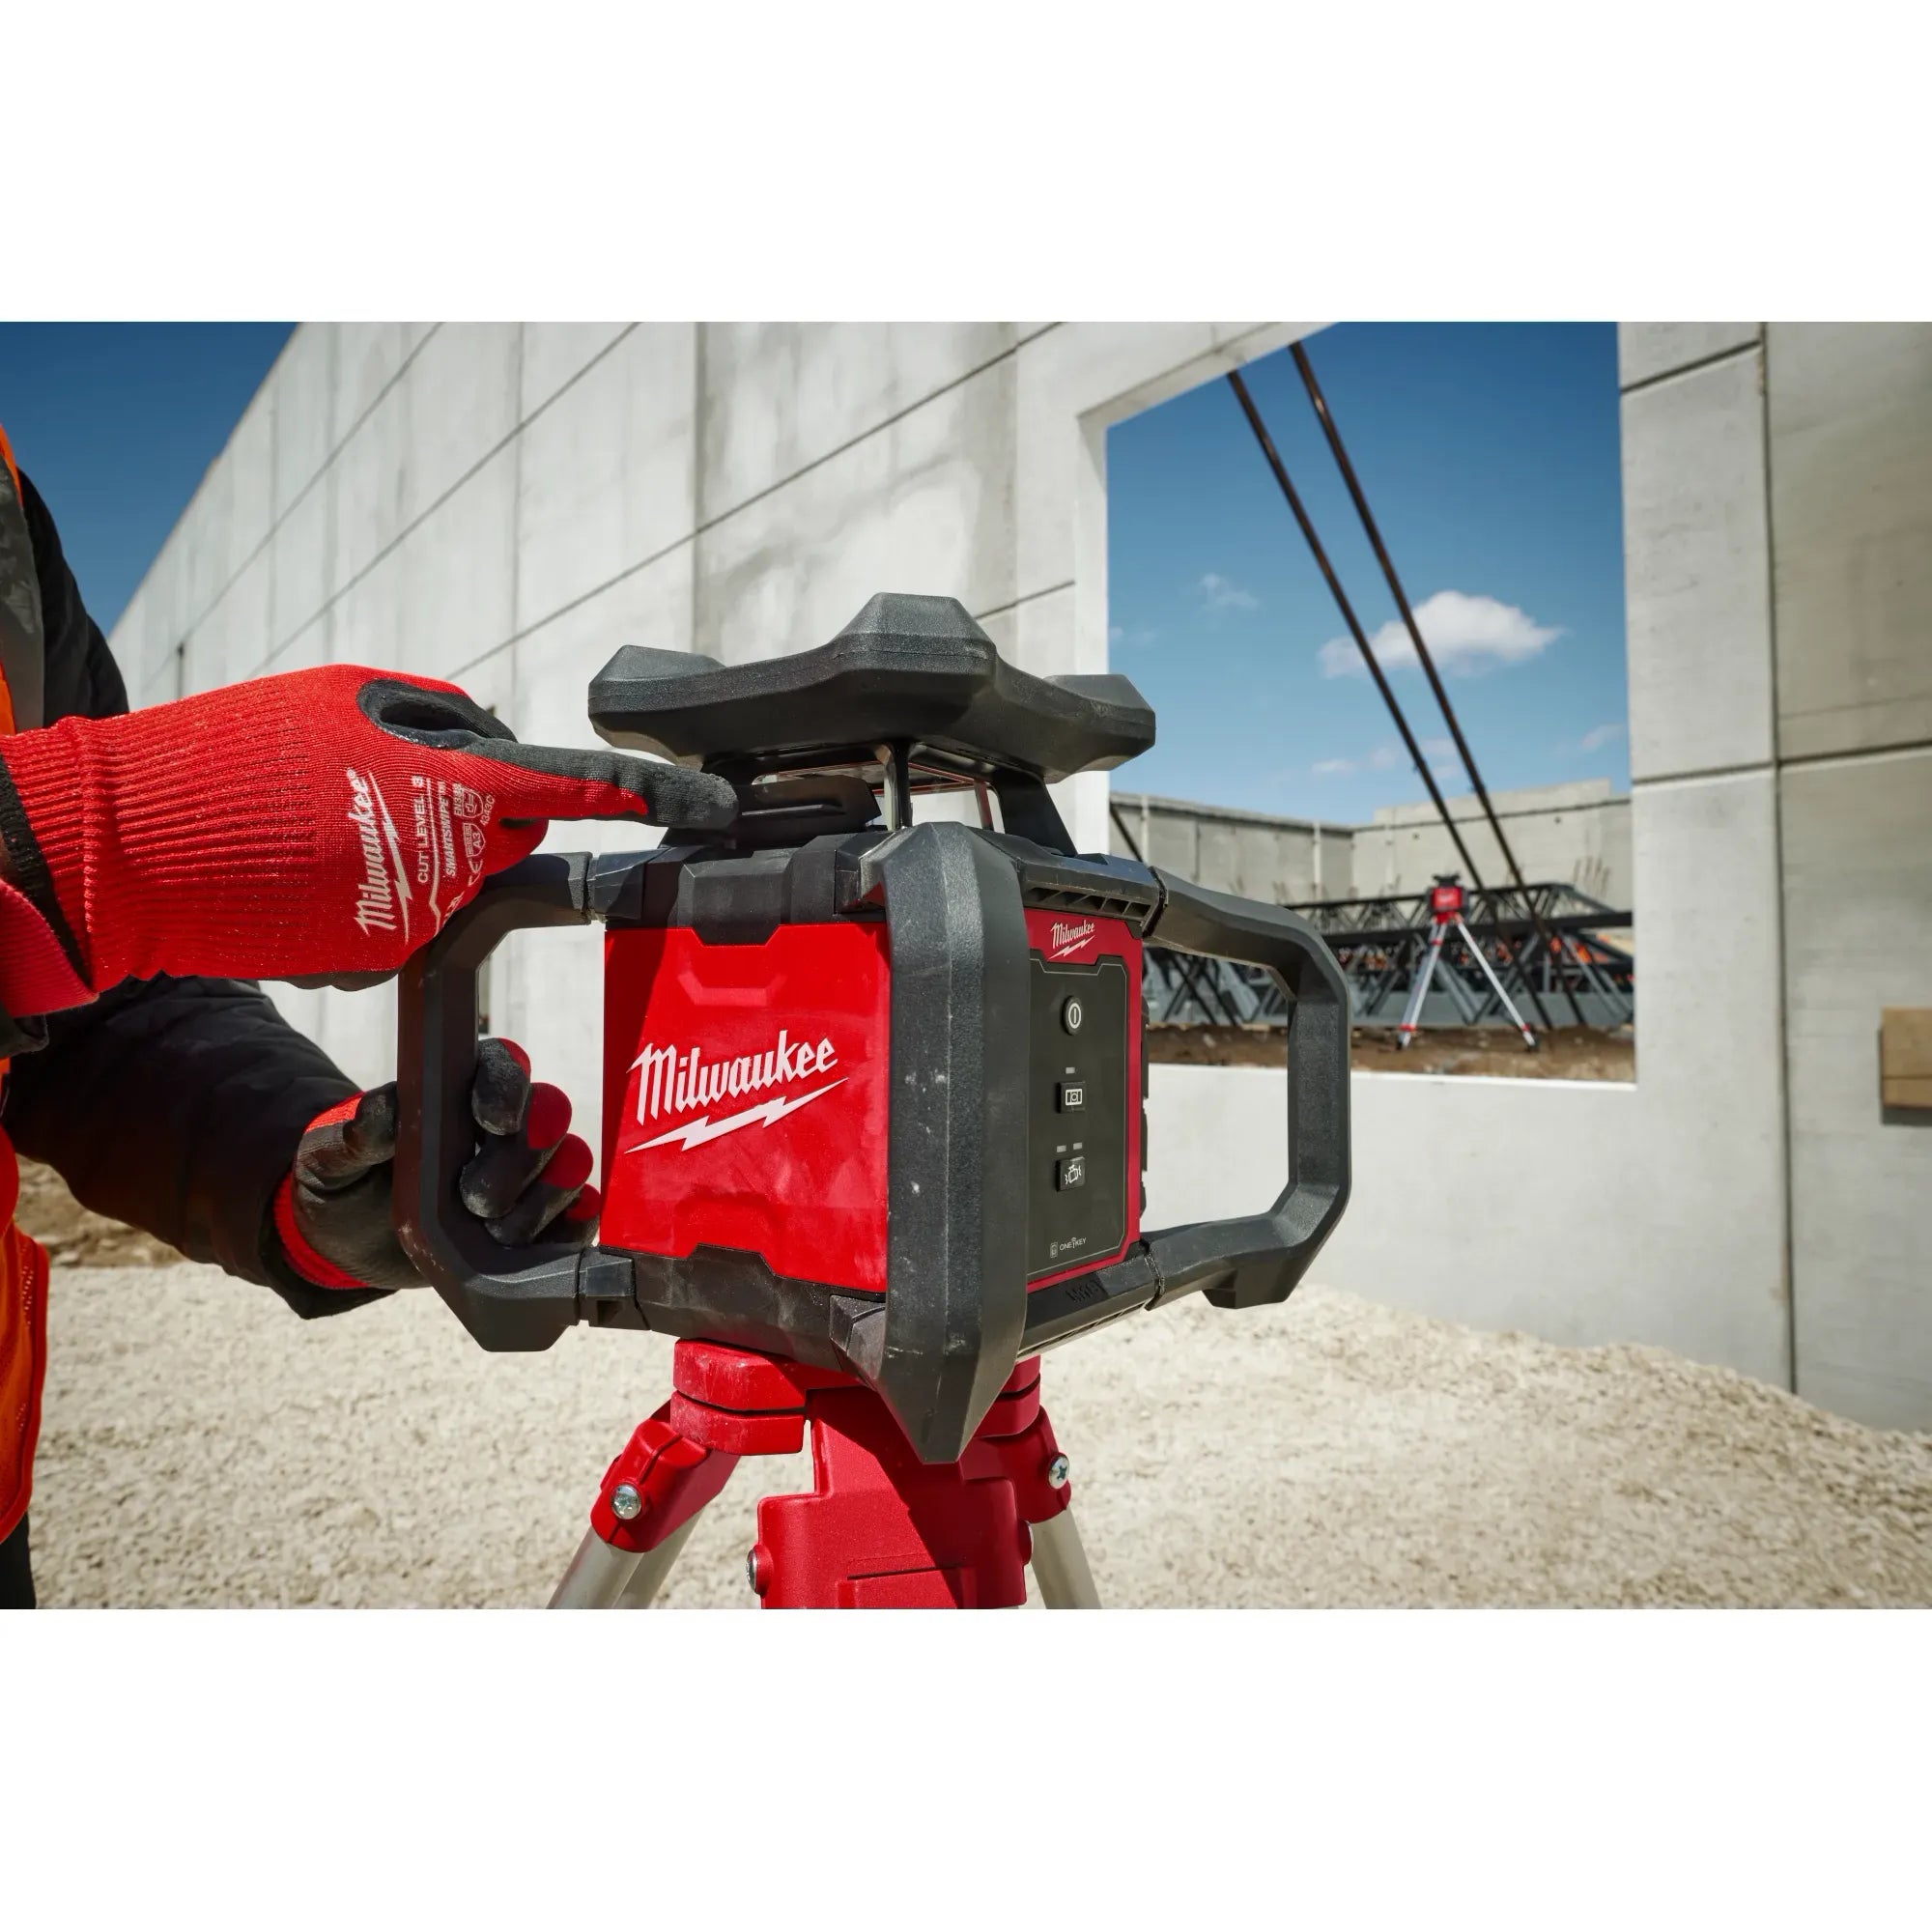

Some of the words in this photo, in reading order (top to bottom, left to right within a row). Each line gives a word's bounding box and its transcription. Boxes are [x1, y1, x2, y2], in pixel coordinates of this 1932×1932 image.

[414, 797, 430, 848] LEVEL
[472, 832, 481, 848] A3
[348, 776, 397, 936] Milwaukee
[417, 852, 430, 884] CUT
[1050, 919, 1095, 950] Milwaukee
[626, 1029, 838, 1126] Milwaukee
